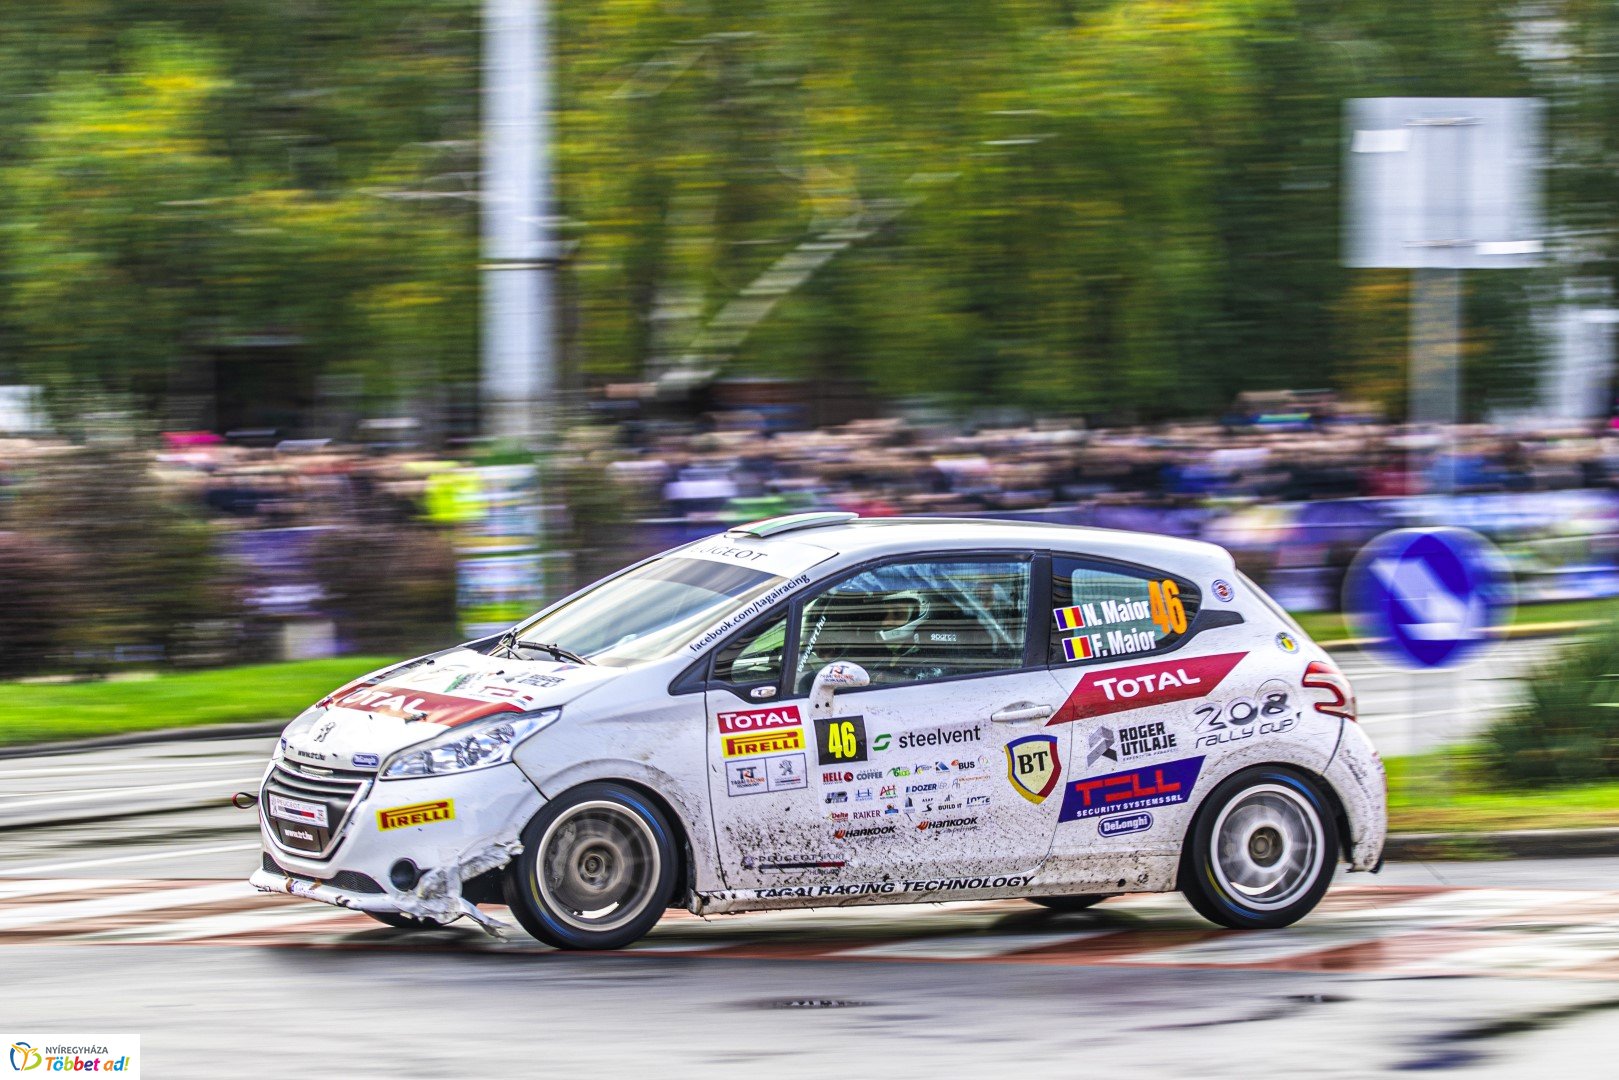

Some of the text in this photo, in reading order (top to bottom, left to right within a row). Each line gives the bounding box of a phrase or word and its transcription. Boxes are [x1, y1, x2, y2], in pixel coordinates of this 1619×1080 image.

[689, 574, 811, 652] facebook.com/tagairacing
[1082, 597, 1150, 627] N. Maior
[1147, 579, 1188, 635] 46
[1091, 627, 1157, 658] F. Maior
[1093, 668, 1201, 701] TOTAL
[343, 688, 427, 717] OTAL
[1193, 690, 1290, 733] 208
[719, 710, 798, 730] TOTAL
[1119, 722, 1165, 742] ROGER
[725, 731, 800, 756] PIRELLI
[828, 721, 857, 759] 46
[899, 725, 981, 748] steelvent
[1121, 733, 1177, 756] UTILAJE
[958, 761, 976, 770] BUS
[1017, 750, 1049, 775] BT
[822, 771, 883, 782] HELL COFFEE
[911, 783, 938, 792] DOZER
[1075, 769, 1181, 806] TELL
[380, 801, 451, 830] PIRELLI
[1076, 794, 1183, 818] SECURITY SYSTEMS SRL
[1103, 815, 1148, 832] DeLonghi
[754, 875, 1036, 899] TAGAI RACING TECHNOLOGY
